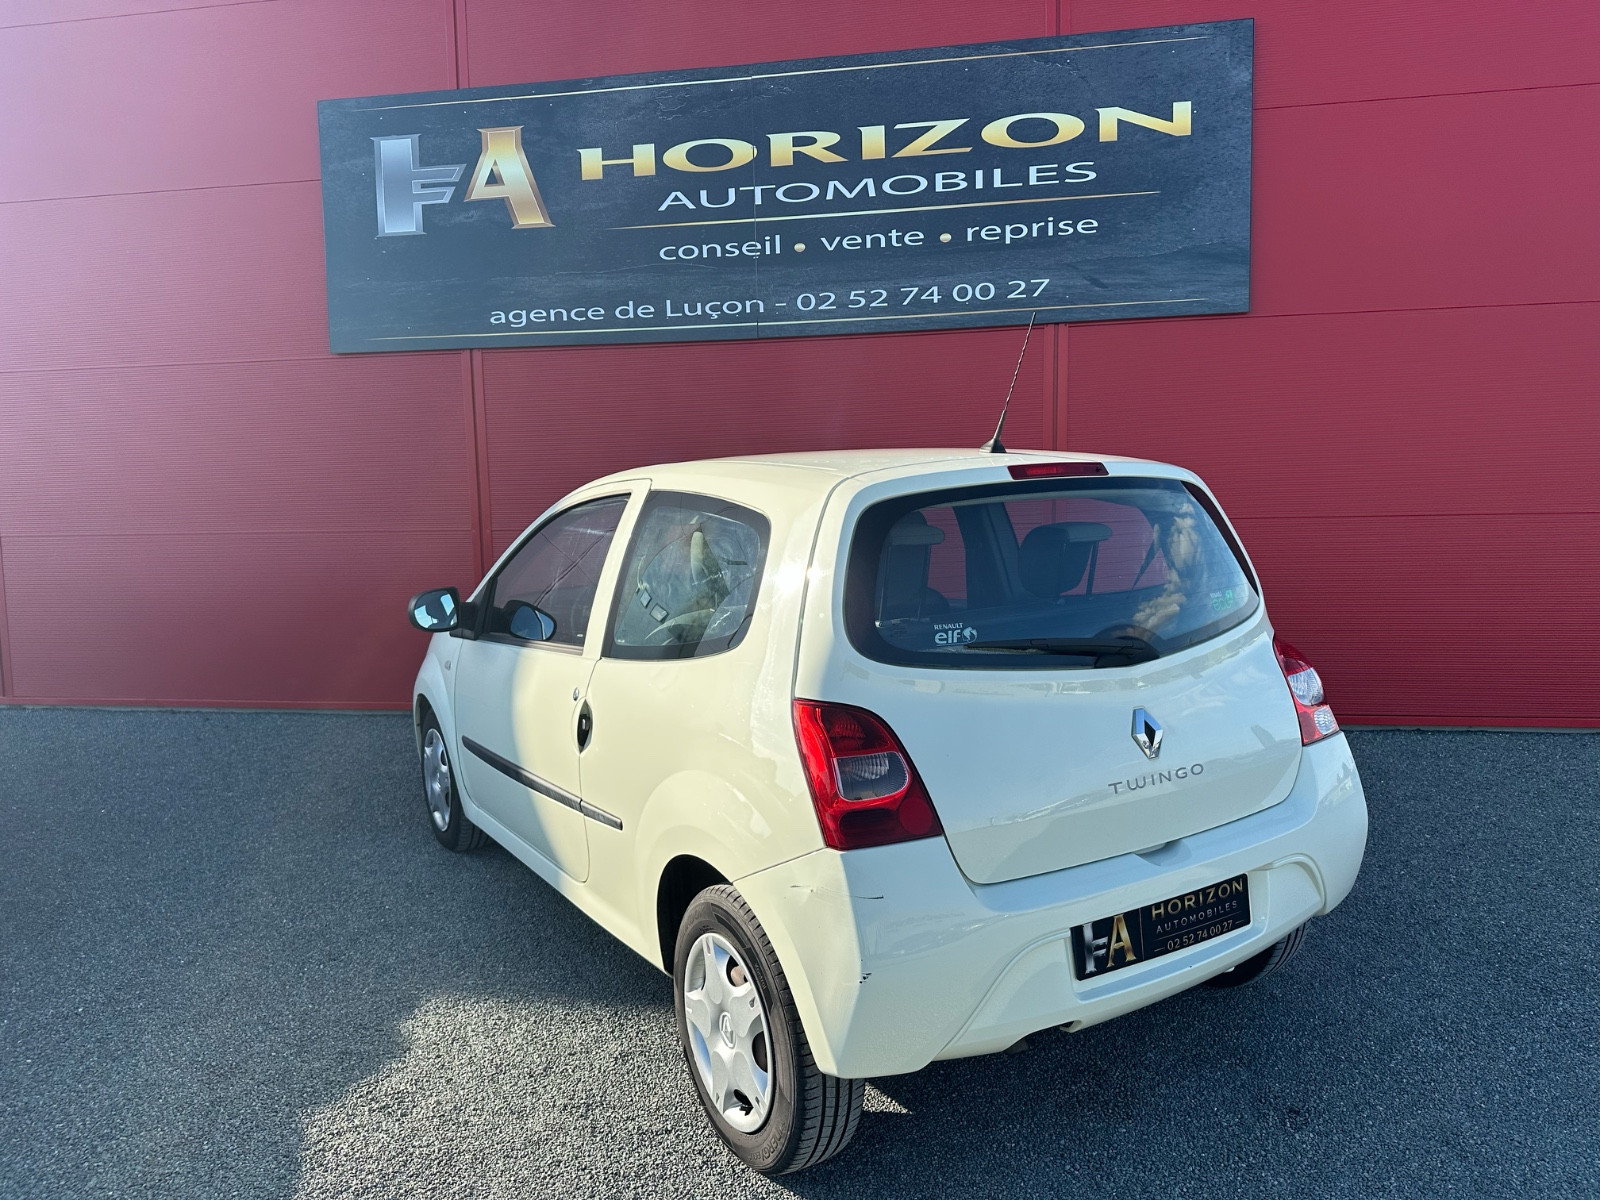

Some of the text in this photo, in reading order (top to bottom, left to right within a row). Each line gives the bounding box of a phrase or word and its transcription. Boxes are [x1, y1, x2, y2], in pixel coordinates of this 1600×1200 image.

[577, 101, 1192, 180] HORIZON
[658, 162, 1097, 211] AUTOMOBILES
[659, 216, 1098, 260] conseil vente reprise
[489, 306, 606, 327] agence
[614, 300, 656, 320] de
[666, 299, 764, 319] Luçon
[796, 293, 836, 311] 02
[848, 289, 888, 307] 52
[900, 286, 941, 304] 74
[952, 282, 995, 301] 00
[1007, 278, 1050, 298] 27
[934, 622, 964, 631] RENAULT
[934, 630, 962, 645] elf
[1108, 763, 1204, 795] TWINGO
[1151, 878, 1243, 921] HORIZON
[1155, 900, 1238, 934] AUTOMOBILES
[1167, 919, 1234, 951] 02 52 74 00 27
